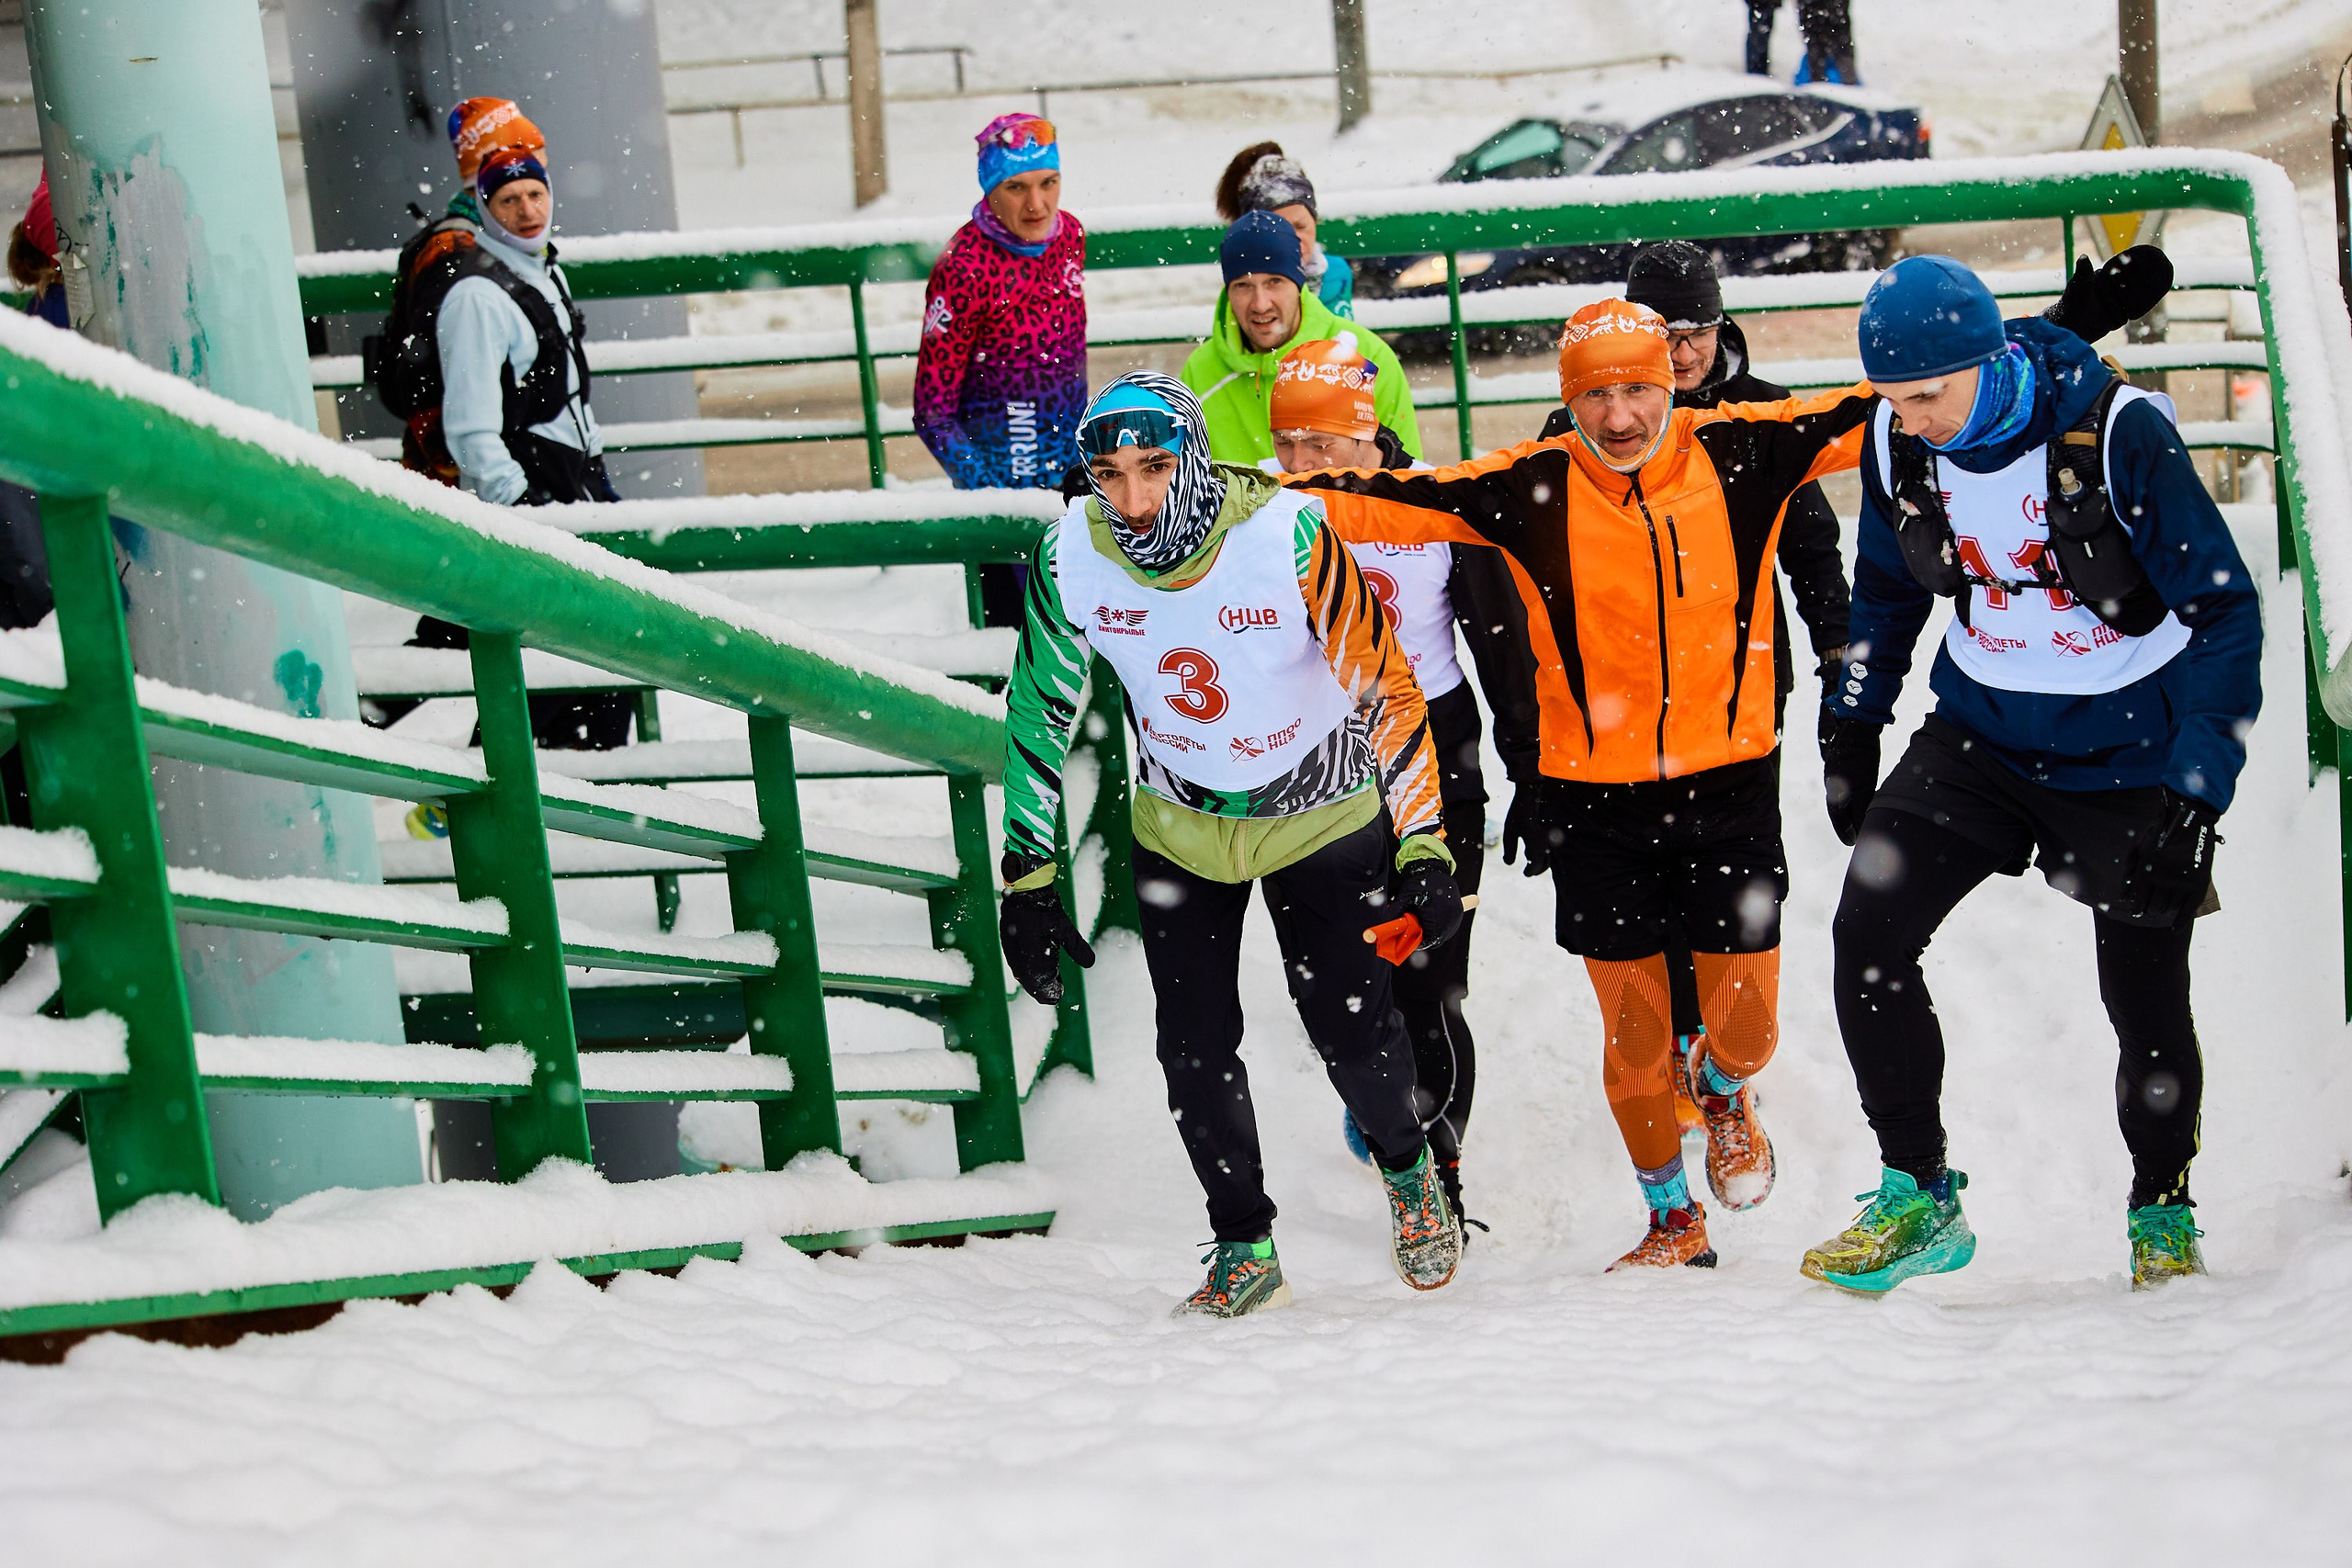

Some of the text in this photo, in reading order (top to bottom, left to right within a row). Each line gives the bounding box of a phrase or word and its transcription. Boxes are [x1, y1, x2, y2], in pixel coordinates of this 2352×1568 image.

[1227, 608, 1278, 626] НЦВ
[1098, 625, 1146, 636] ВИНТОКРЫЛЫЕ
[1158, 647, 1228, 724] 3
[1269, 732, 1296, 750] НЦВ
[2194, 825, 2208, 863] SPORTS
